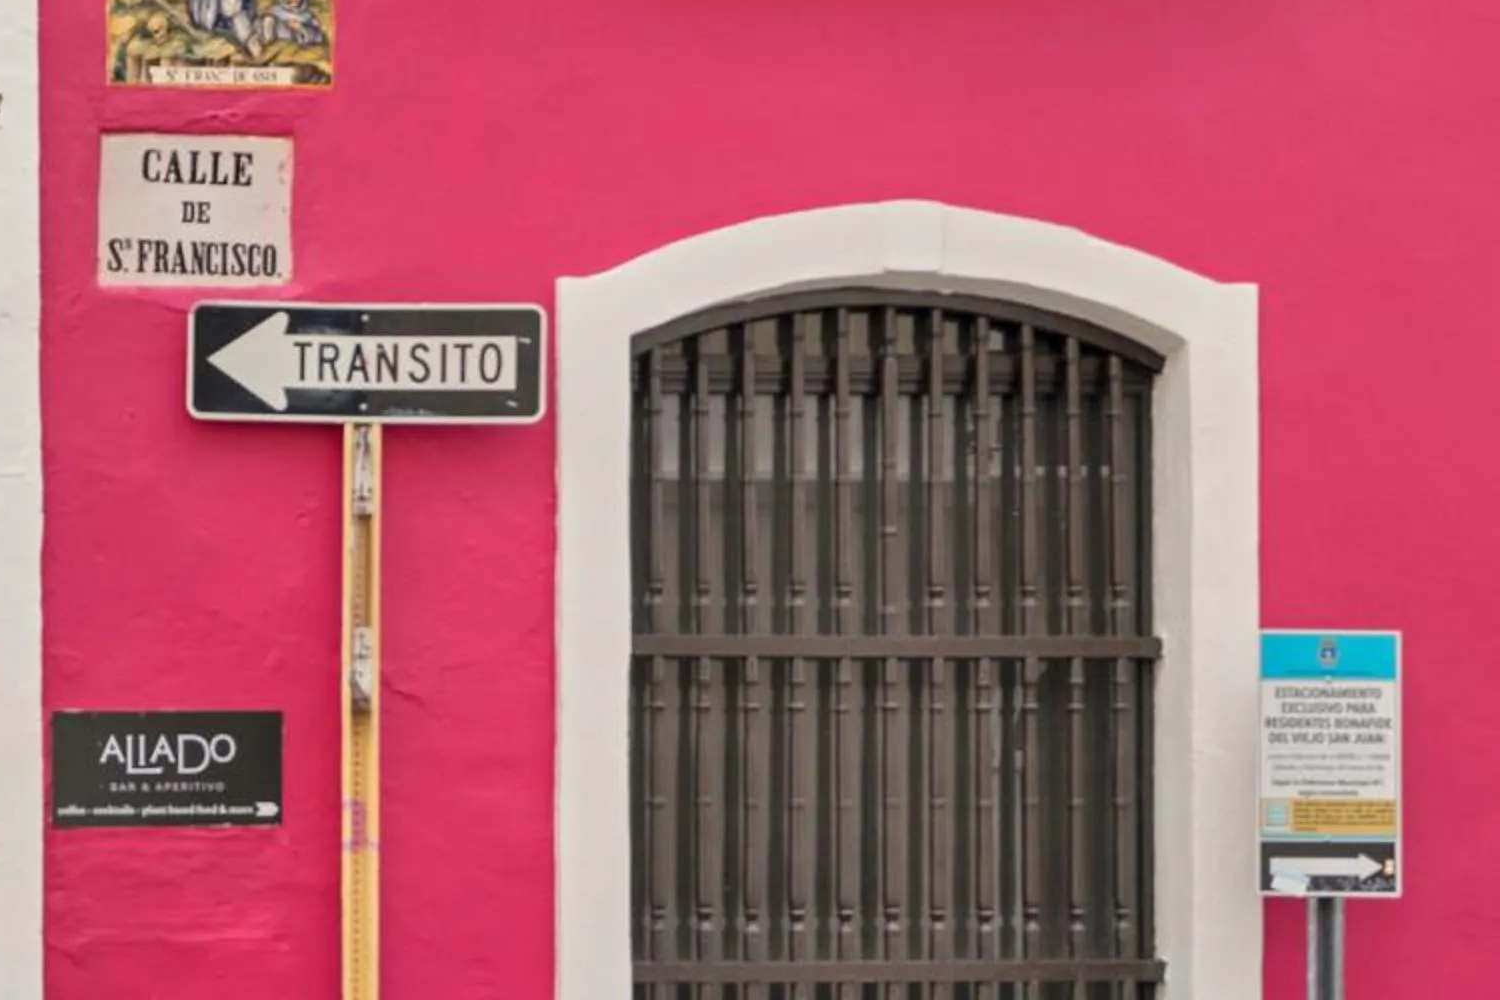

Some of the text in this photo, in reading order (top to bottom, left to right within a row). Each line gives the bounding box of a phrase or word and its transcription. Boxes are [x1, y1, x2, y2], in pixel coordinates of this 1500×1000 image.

[141, 149, 253, 187] CALLE
[181, 201, 211, 224] DE
[294, 341, 504, 384] TRANSITO
[1274, 686, 1382, 699] ESTACIONAMIENTO
[1281, 701, 1378, 714] EXCLUSIVO PARA
[1265, 717, 1331, 729] RESIDENTES
[1268, 732, 1385, 744] DEL VIEJO SAN JUAN
[99, 733, 237, 775] ALIADO
[109, 781, 226, 792] BAR & APERITIVO
